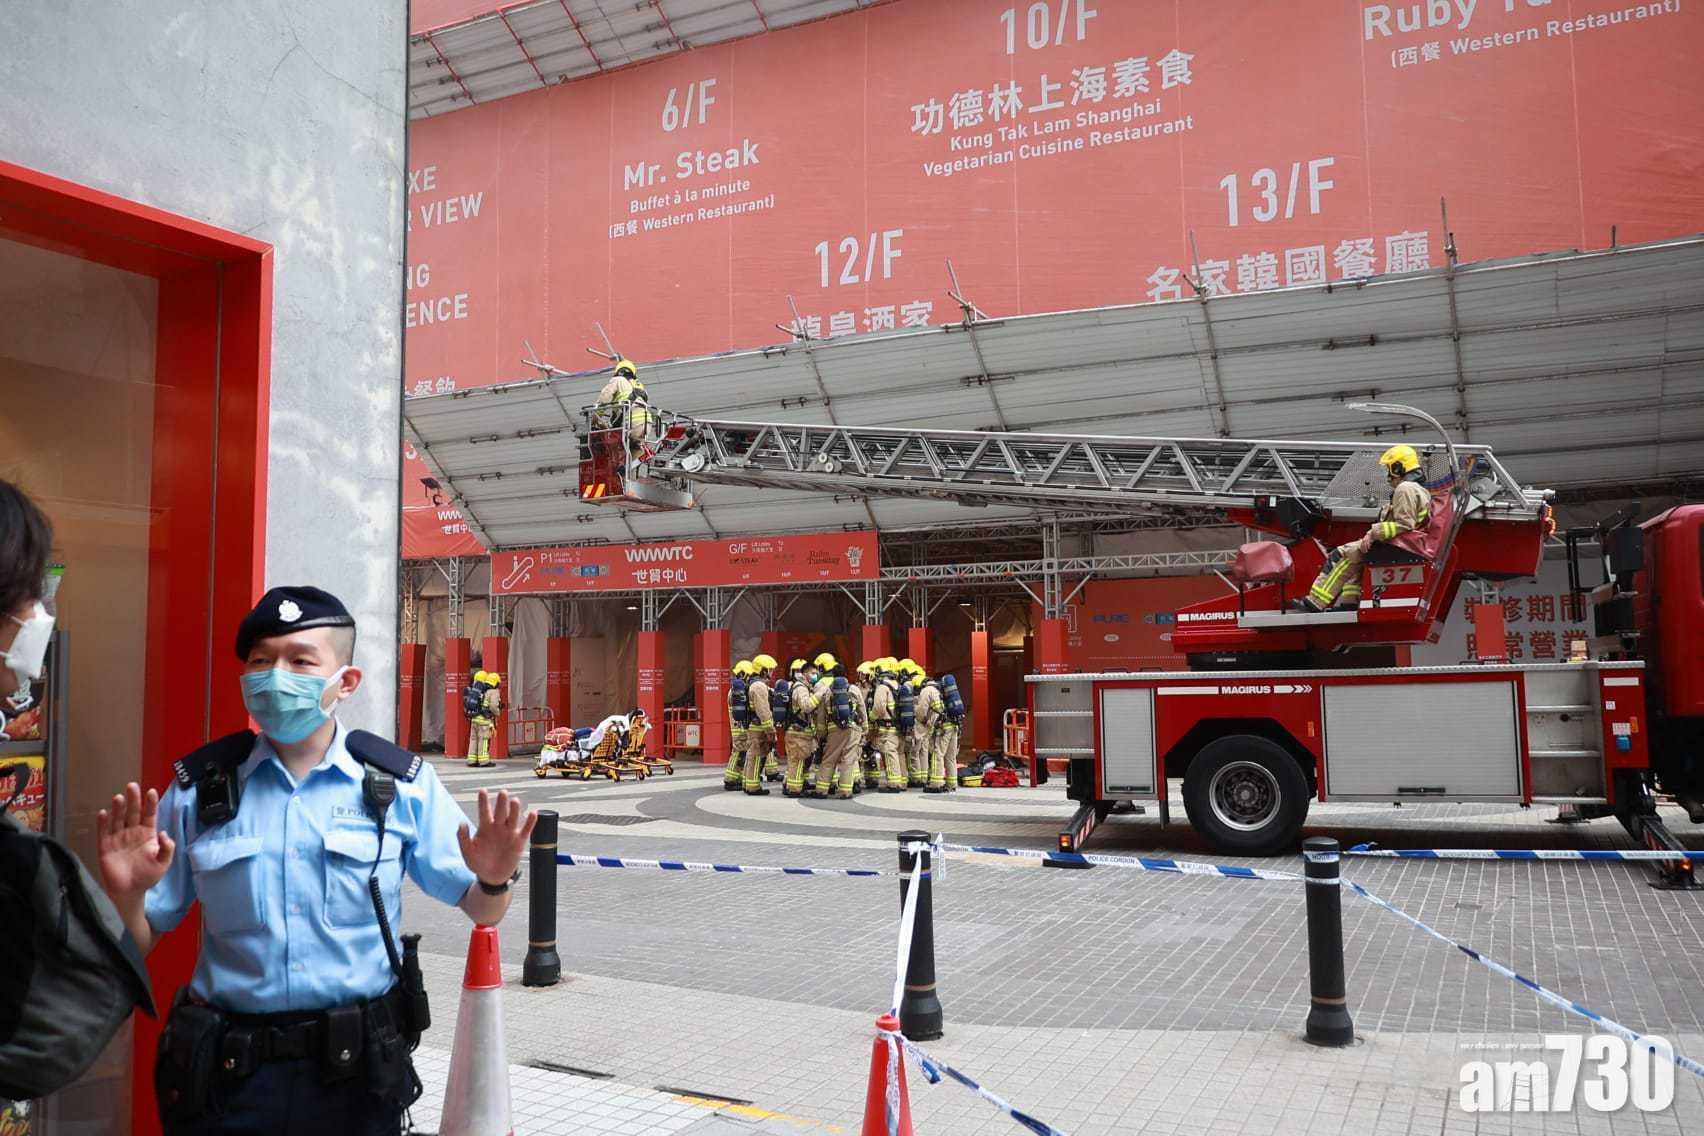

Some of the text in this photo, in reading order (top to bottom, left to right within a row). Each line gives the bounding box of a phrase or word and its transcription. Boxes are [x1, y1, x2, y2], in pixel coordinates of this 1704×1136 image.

[1000, 0, 1097, 55] 10/F
[1364, 0, 1479, 40] Ruby
[1449, 25, 1539, 56] Western
[1546, 0, 1682, 37] Restaurant)
[662, 78, 717, 131] 6/F
[911, 49, 1195, 136] 功德林上海素食
[923, 115, 1194, 177] Vegetarian Cuisine Restaurant
[950, 98, 1162, 152] Kung Tak Lam Shanghai
[623, 139, 761, 191] Mr. Steak
[421, 192, 483, 229] VIEW
[630, 191, 669, 214] Buffet
[685, 187, 698, 203] la
[702, 177, 751, 199] minute
[643, 210, 694, 230] Western
[697, 193, 775, 224] Restaurant)
[1219, 157, 1335, 227] 13/F
[814, 229, 905, 288] 12/F
[729, 543, 747, 553] G/F
[632, 568, 687, 584] 世貿中心
[1382, 568, 1411, 584] 37
[1190, 611, 1235, 621] MAGIRUS
[1222, 685, 1271, 694] MAGIRUS
